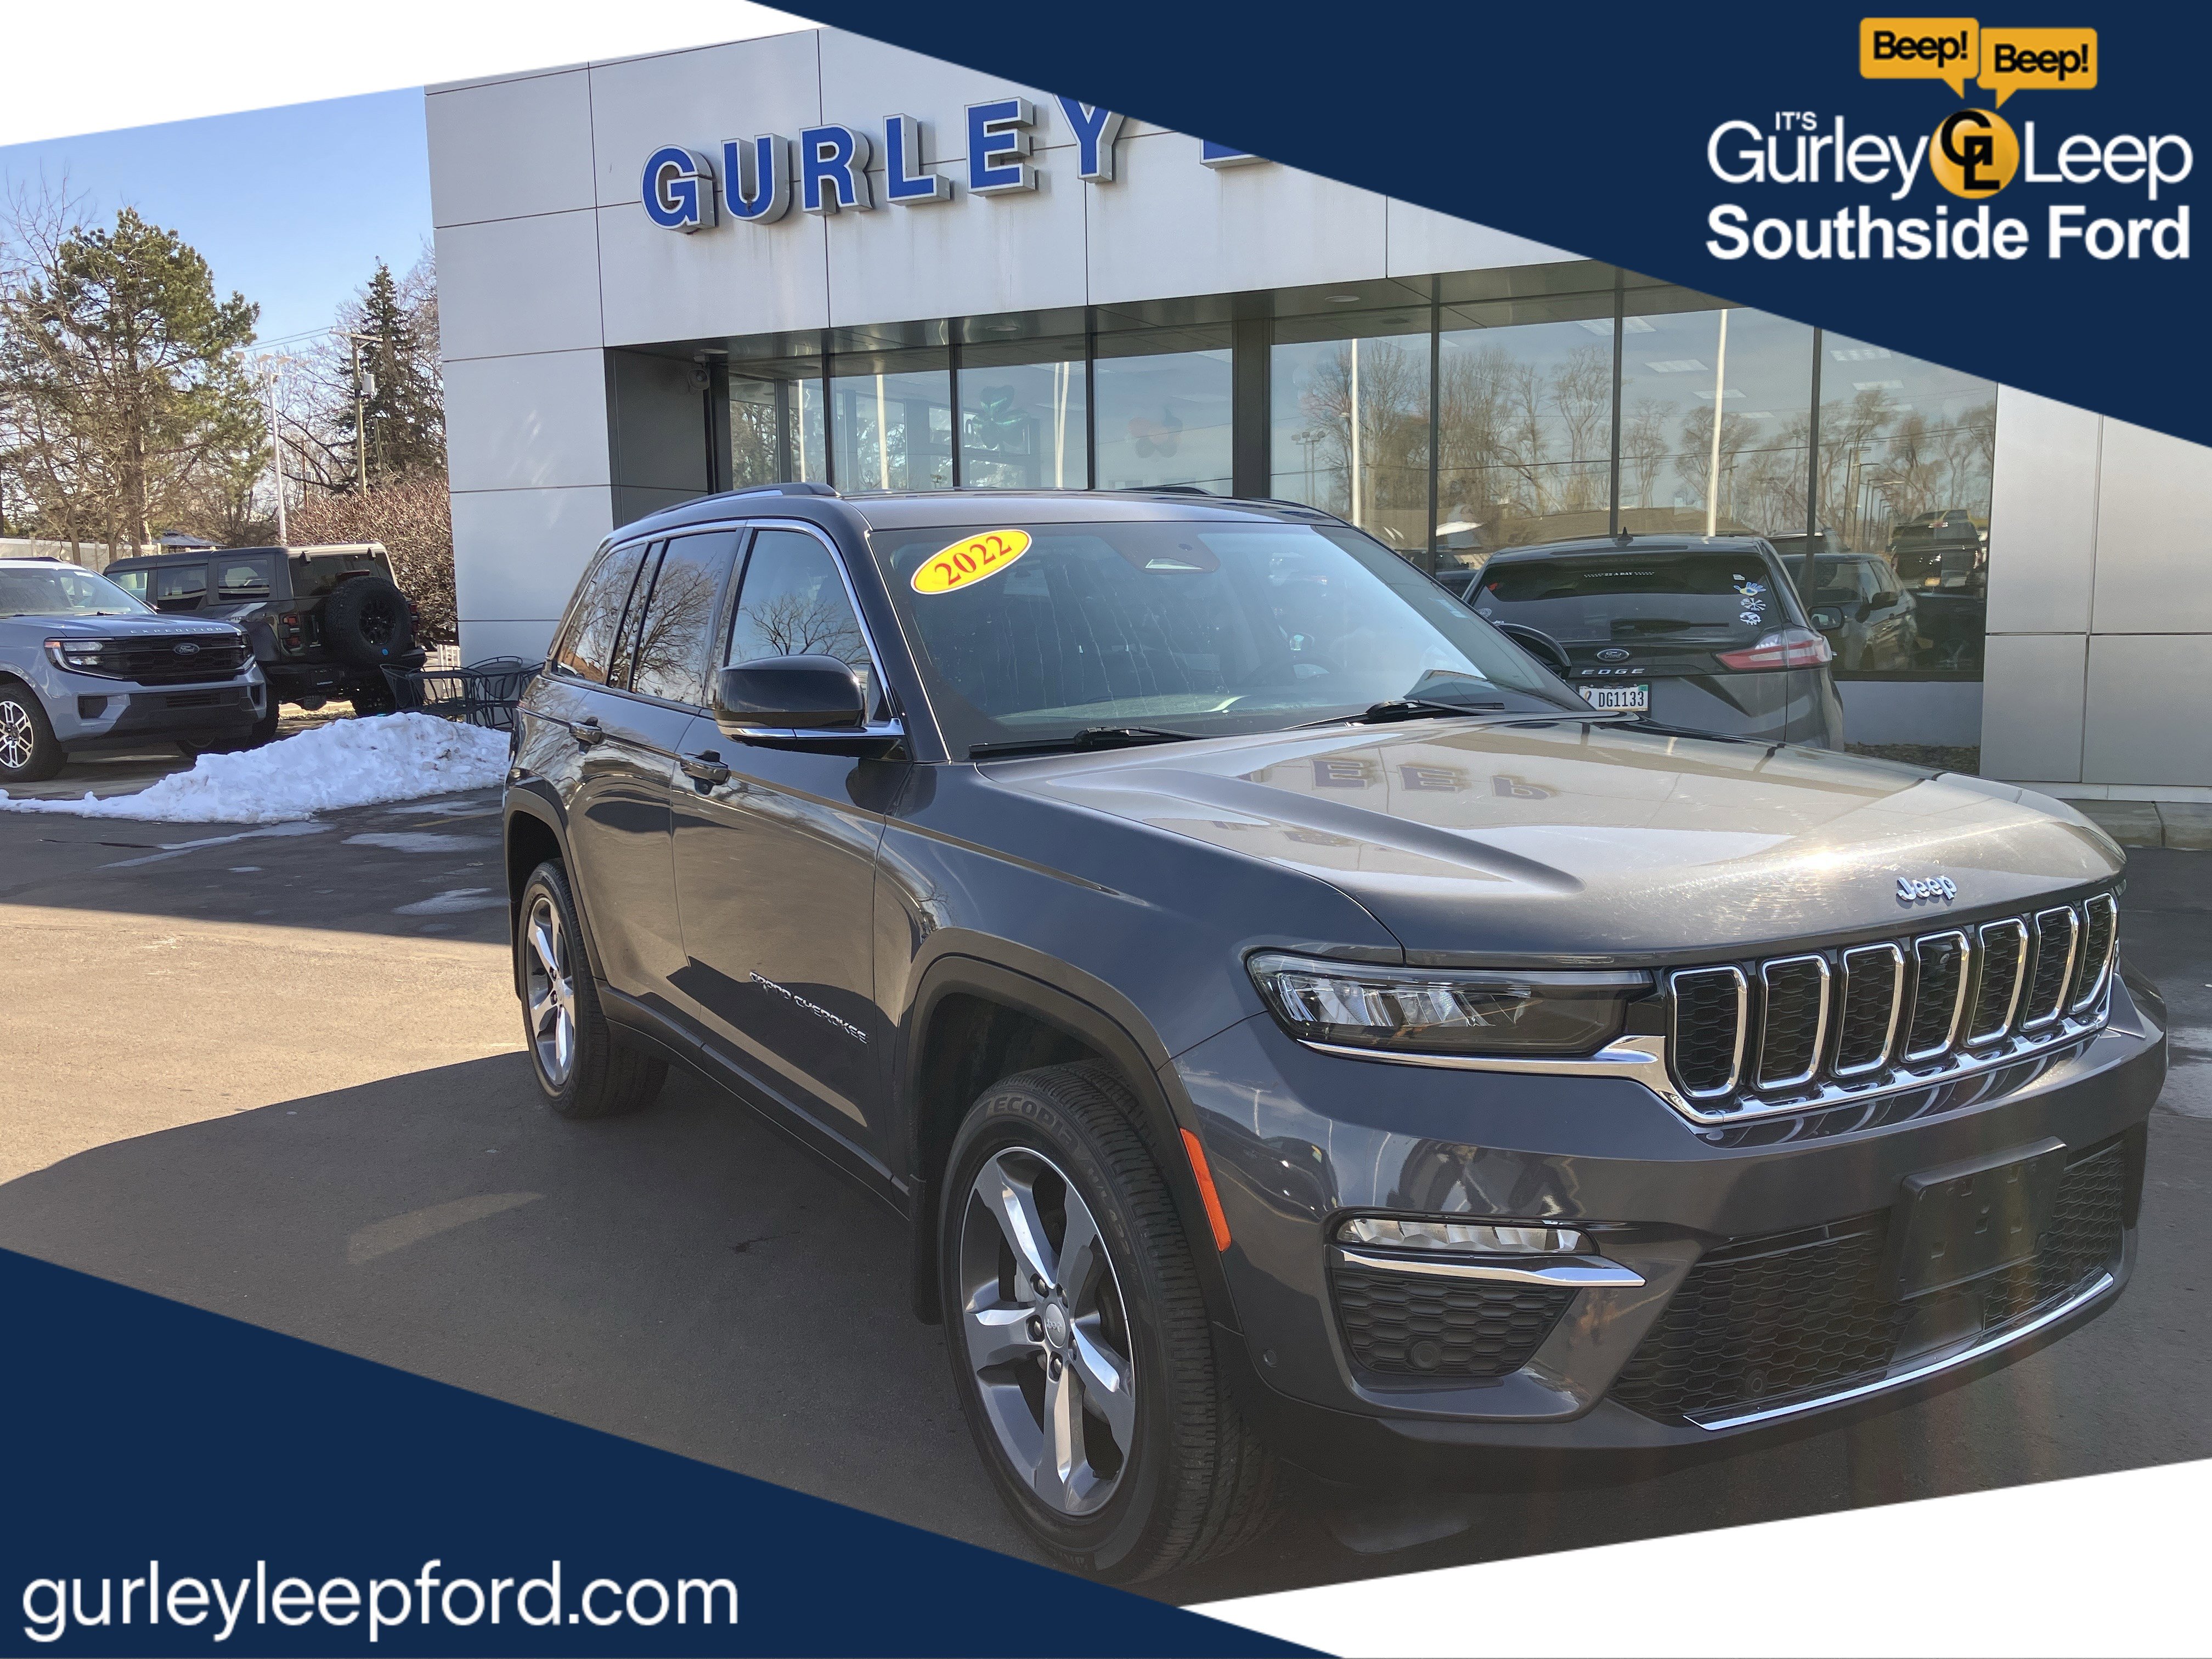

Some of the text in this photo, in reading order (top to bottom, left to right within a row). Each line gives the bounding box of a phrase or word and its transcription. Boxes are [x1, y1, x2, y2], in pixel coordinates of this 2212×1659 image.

[641, 92, 1125, 233] GURLEY
[934, 536, 1012, 585] 2022
[1598, 691, 1644, 707] DG1133
[1896, 875, 1957, 901] Jeep
